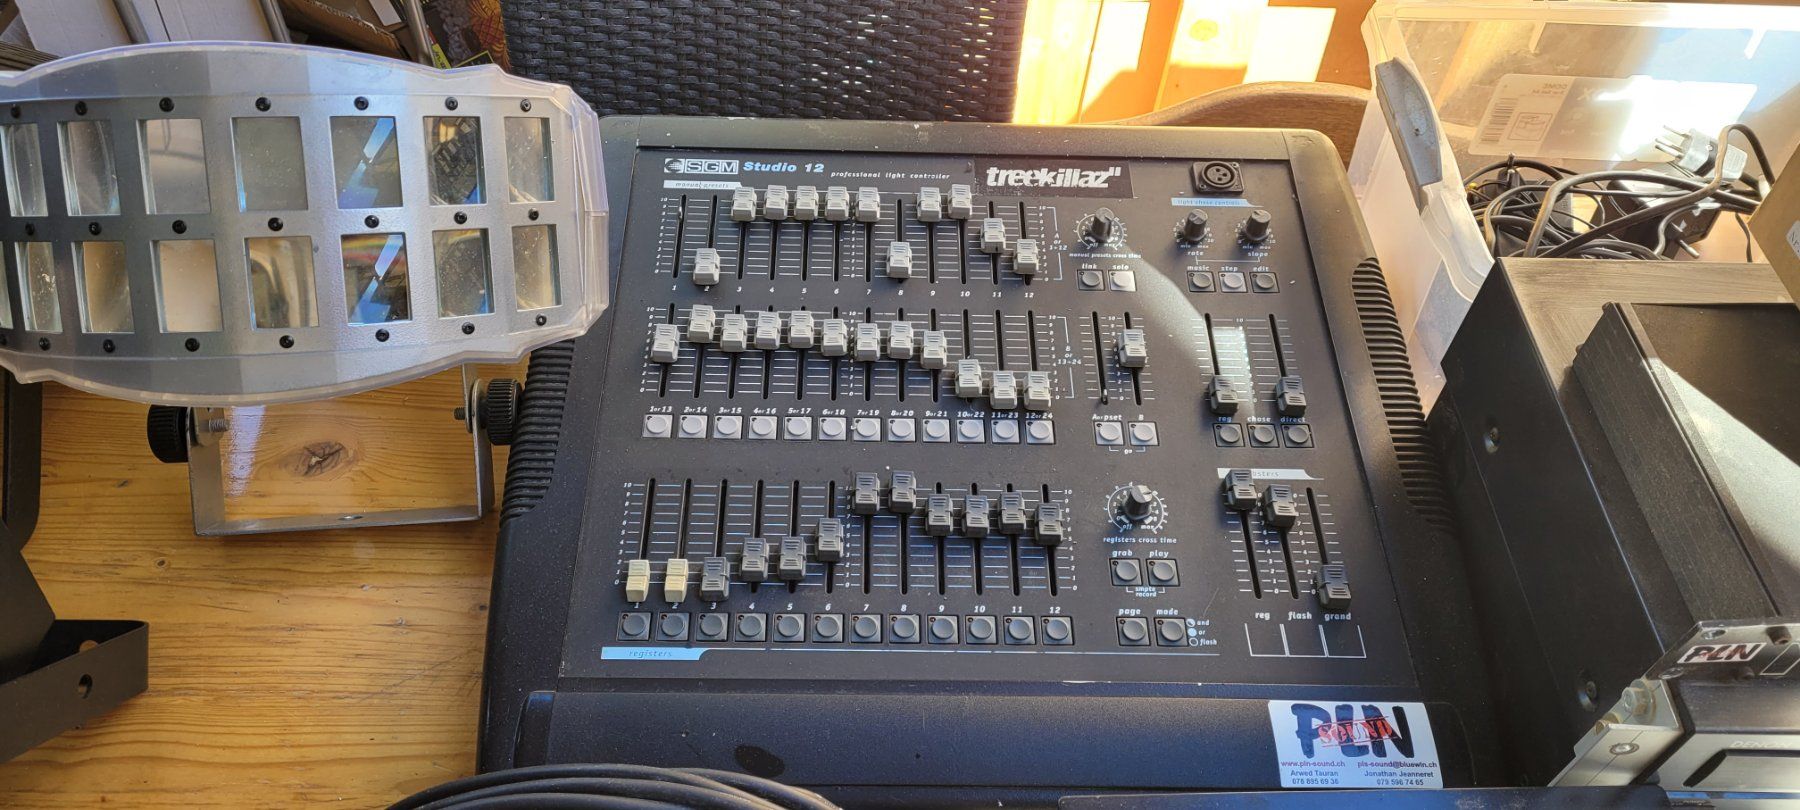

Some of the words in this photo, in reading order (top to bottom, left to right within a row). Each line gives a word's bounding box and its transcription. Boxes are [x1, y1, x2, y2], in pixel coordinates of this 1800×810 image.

[686, 160, 738, 174] SGM
[743, 162, 797, 172] Studio
[804, 164, 824, 172] 12
[1255, 612, 1270, 620] reg
[1288, 612, 1312, 620] flash
[629, 650, 672, 658] registers
[1684, 644, 1762, 662] PLN
[1291, 703, 1414, 758] PLN
[1317, 719, 1394, 743] SOUND
